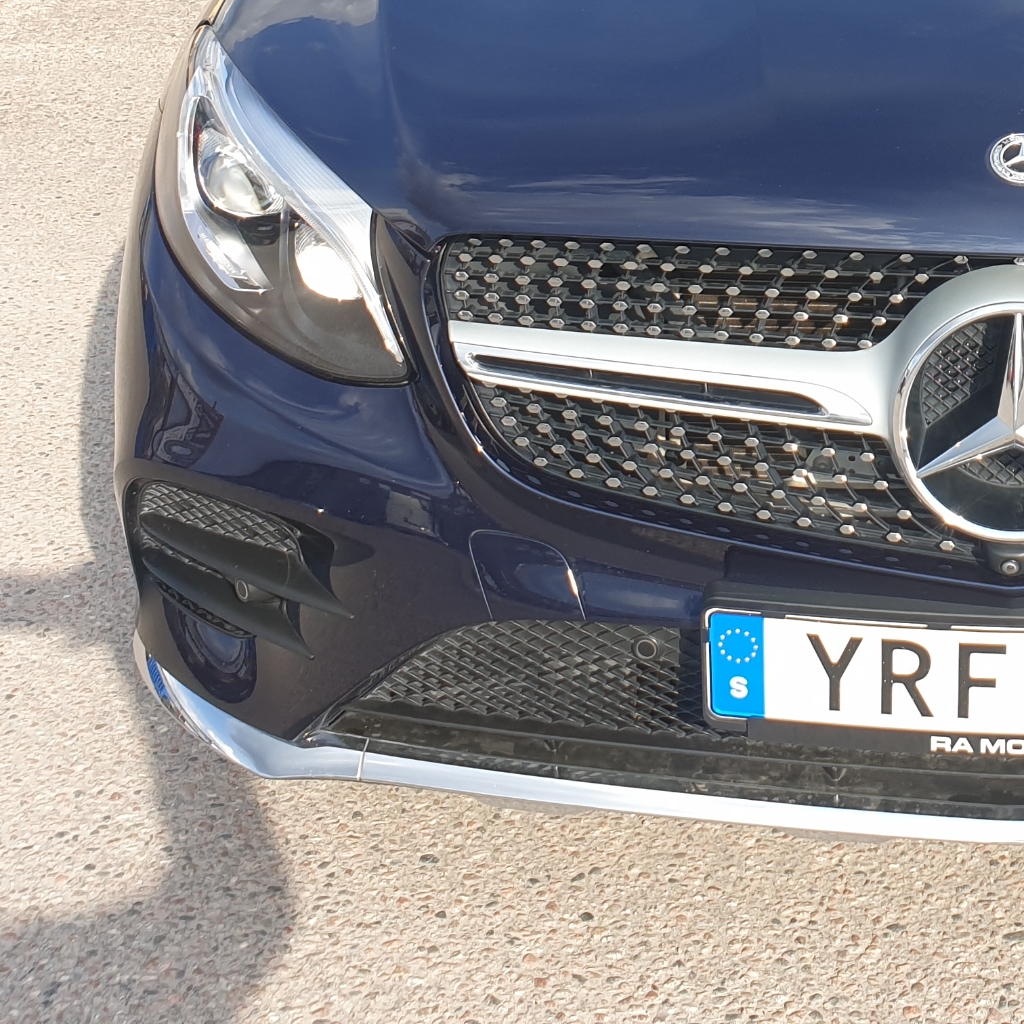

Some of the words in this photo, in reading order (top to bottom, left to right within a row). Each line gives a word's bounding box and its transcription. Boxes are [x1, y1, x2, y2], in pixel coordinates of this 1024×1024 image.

[729, 676, 749, 699] S
[806, 633, 1007, 719] YRF
[930, 735, 974, 754] RA
